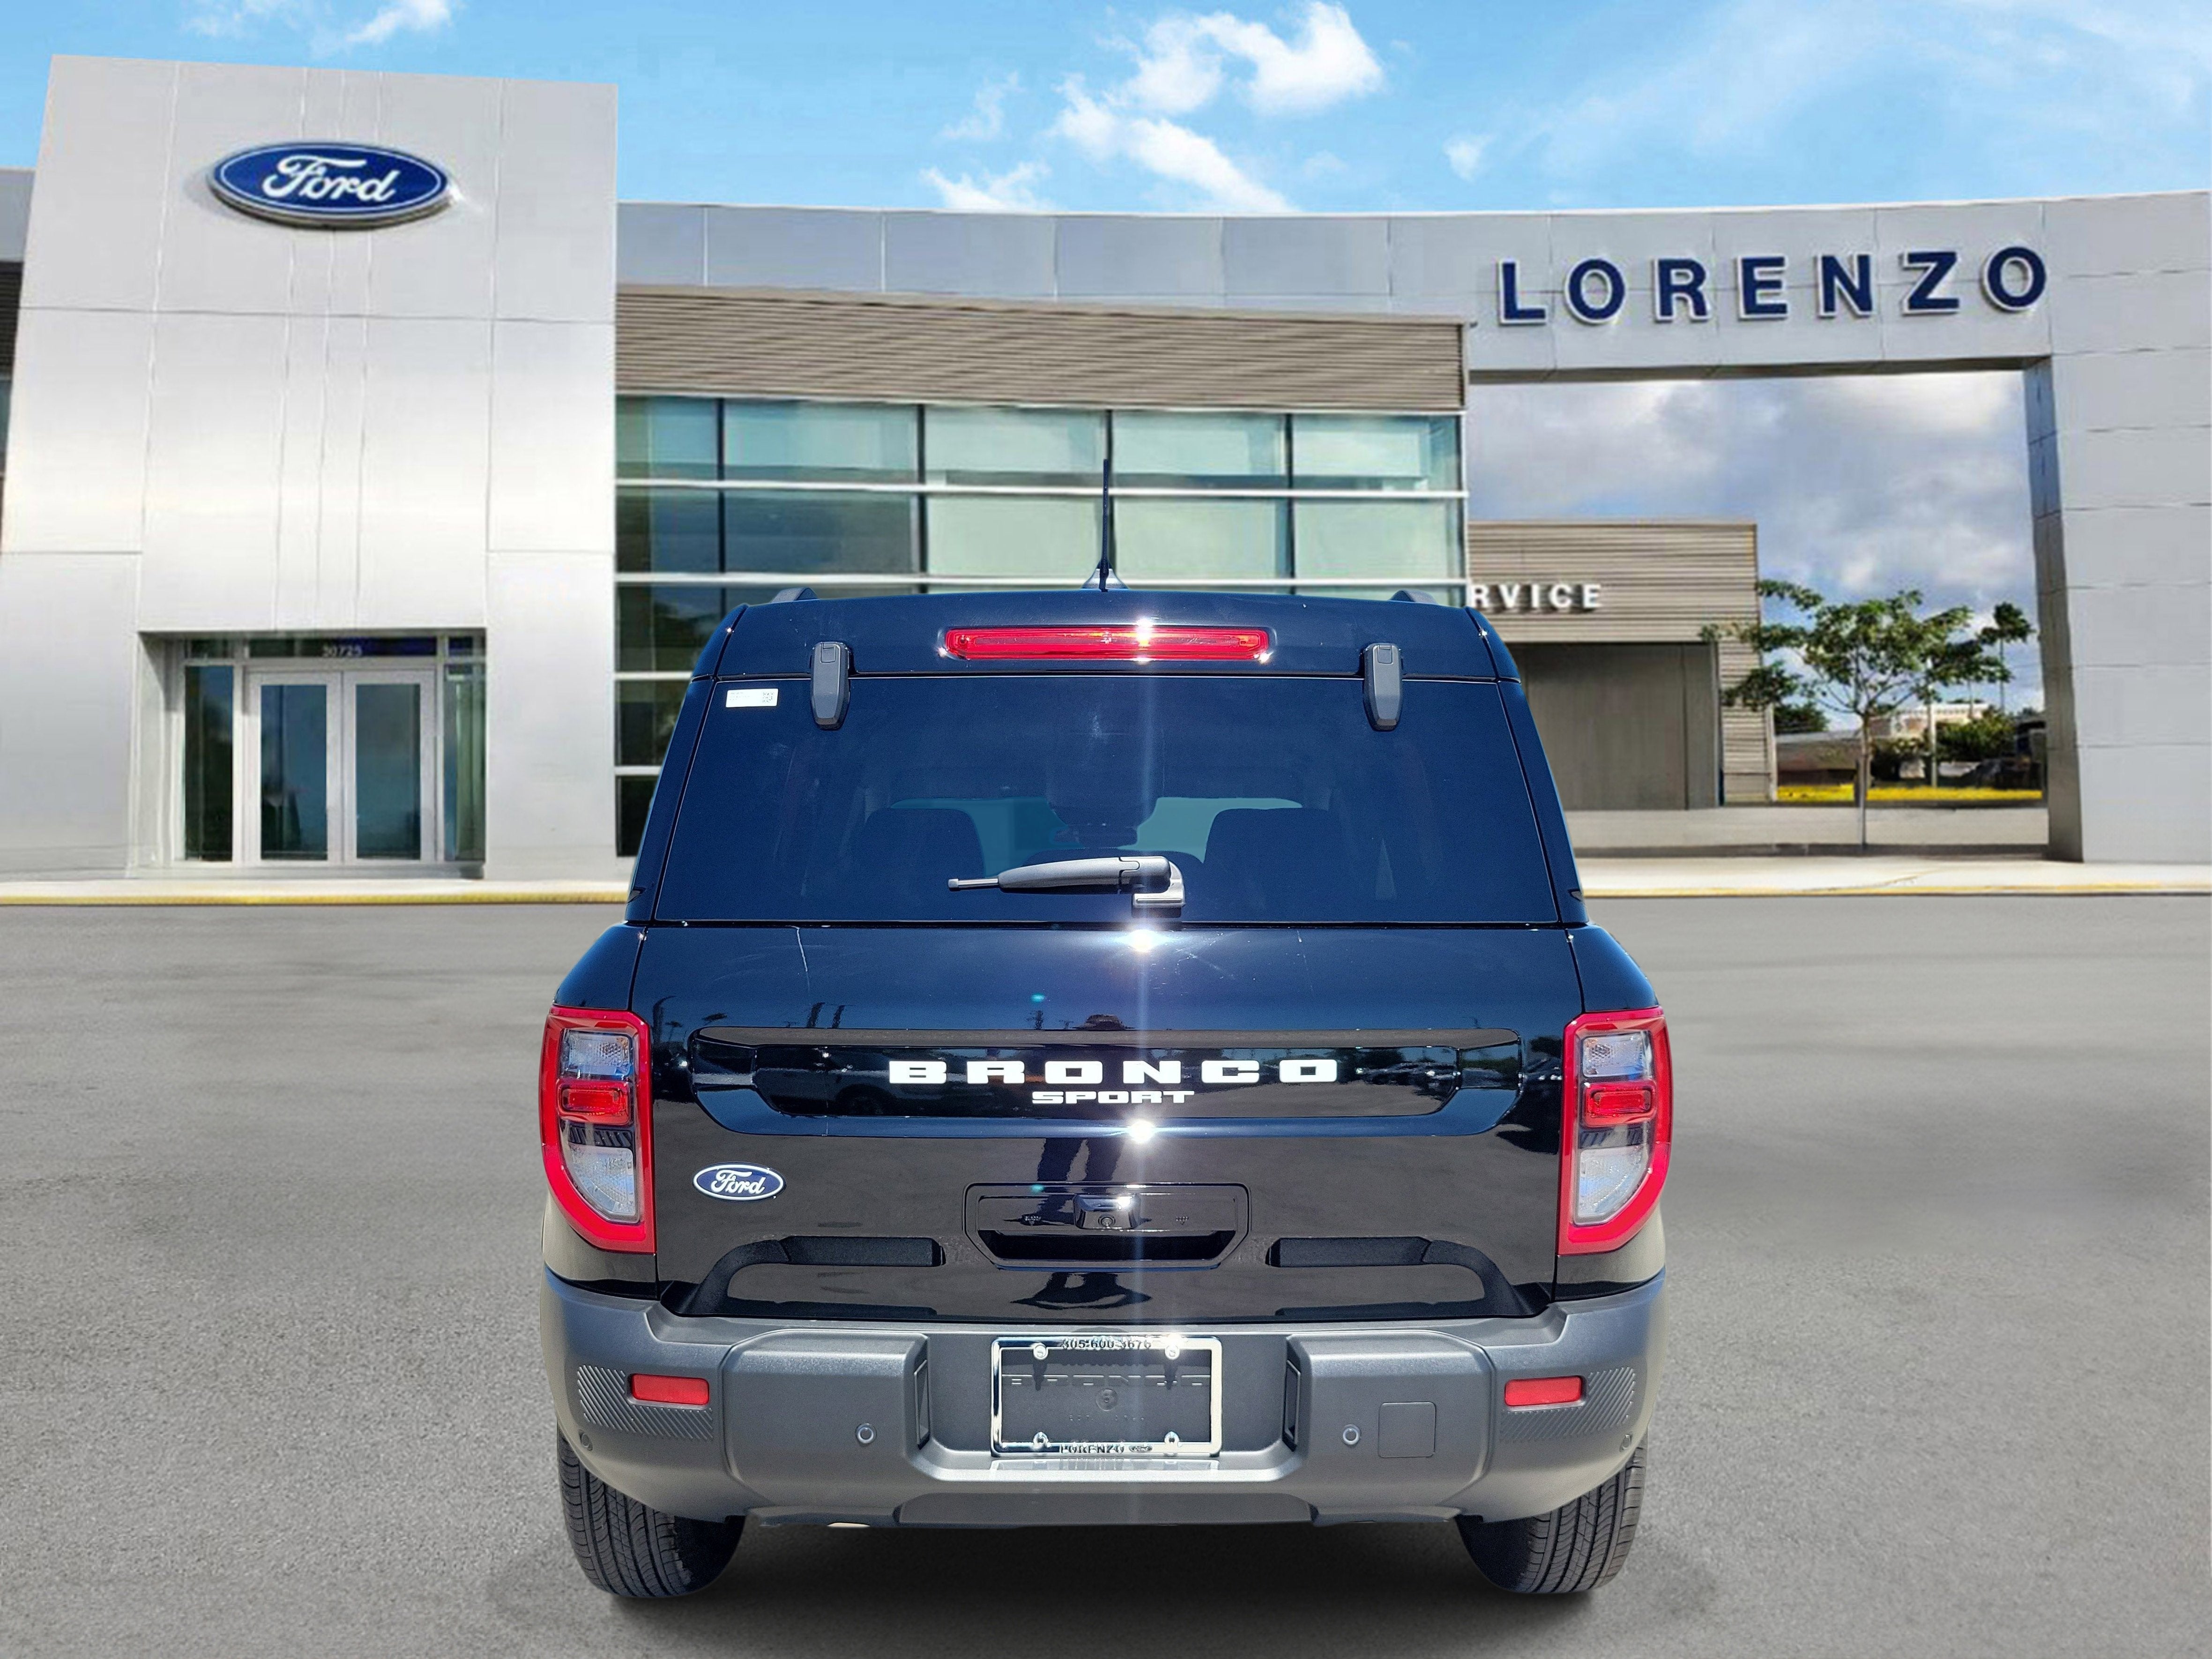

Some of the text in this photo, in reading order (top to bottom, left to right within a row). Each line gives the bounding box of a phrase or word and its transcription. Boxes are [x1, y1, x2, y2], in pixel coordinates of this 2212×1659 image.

[262, 154, 400, 202] Ford
[1499, 246, 2047, 323] LORENZO
[889, 1059, 1338, 1084] BRONCO
[1032, 1091, 1195, 1104] SPORT
[711, 1170, 767, 1194] Ford
